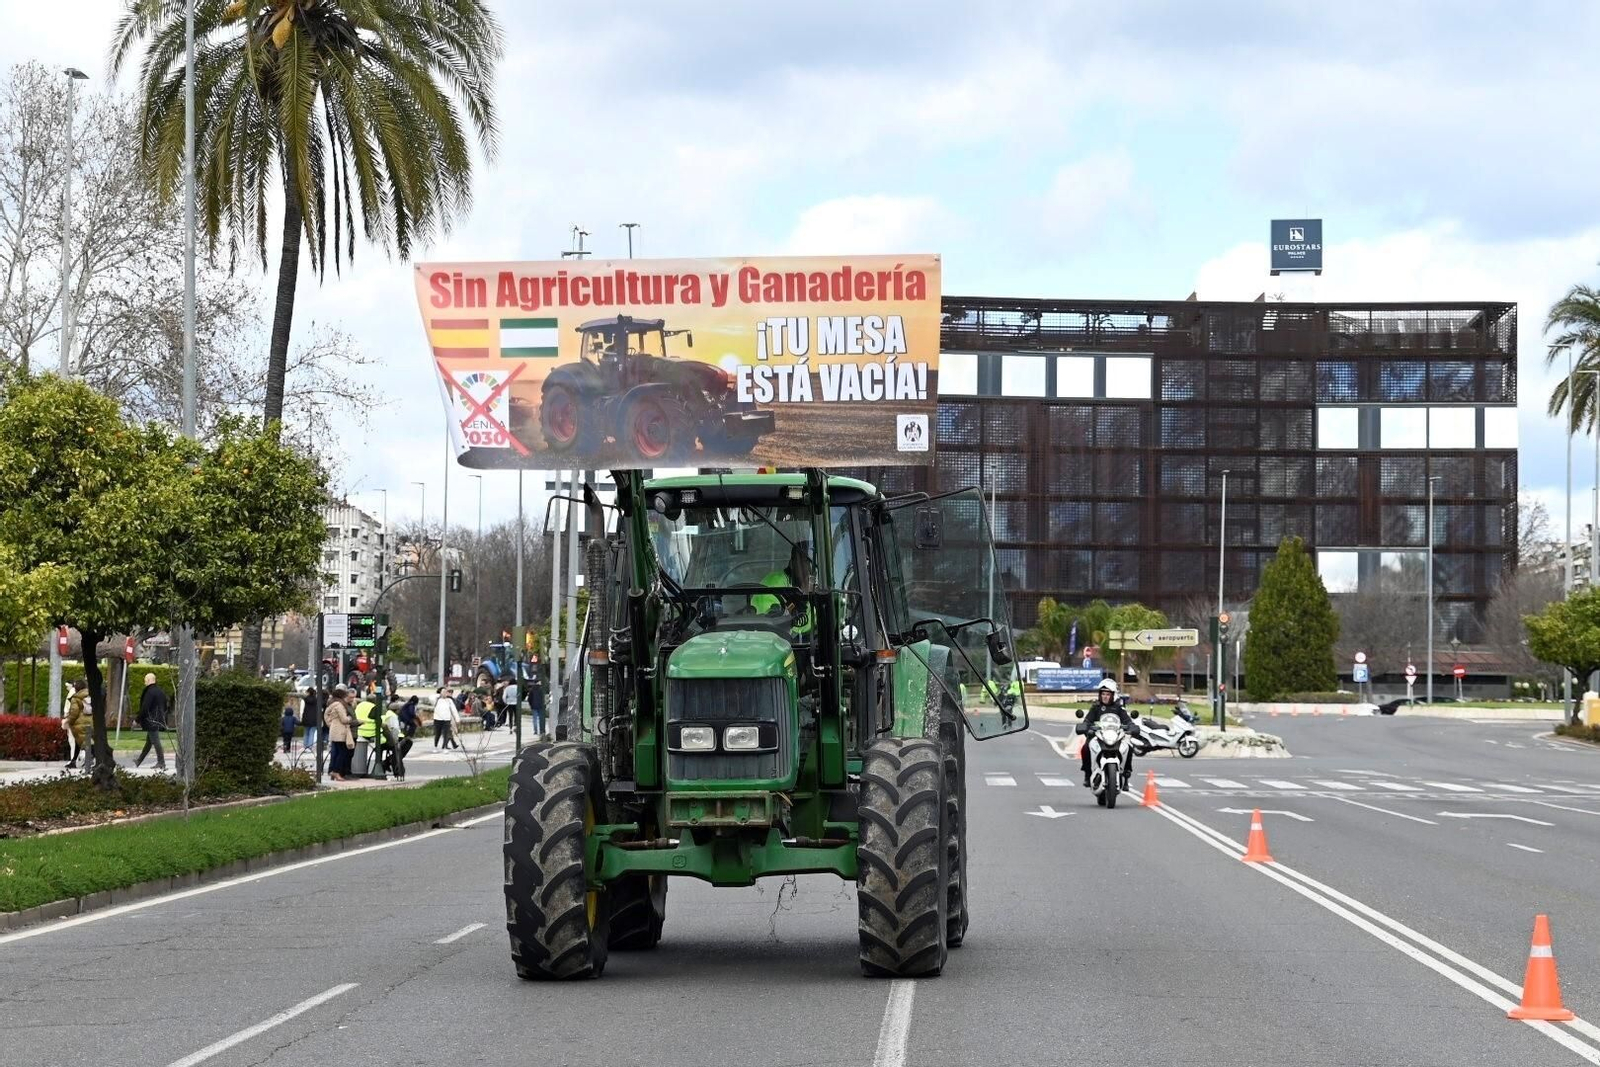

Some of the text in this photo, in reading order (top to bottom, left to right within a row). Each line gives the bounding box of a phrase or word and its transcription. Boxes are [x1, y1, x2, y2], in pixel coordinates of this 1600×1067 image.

[430, 263, 926, 312] Sin Agricultura y Ganadería
[757, 315, 907, 360] ¡TU MESA
[737, 355, 928, 403] ESTÁ VACÍA!
[459, 420, 505, 430] ENA
[1158, 634, 1195, 642] aeropuerto
